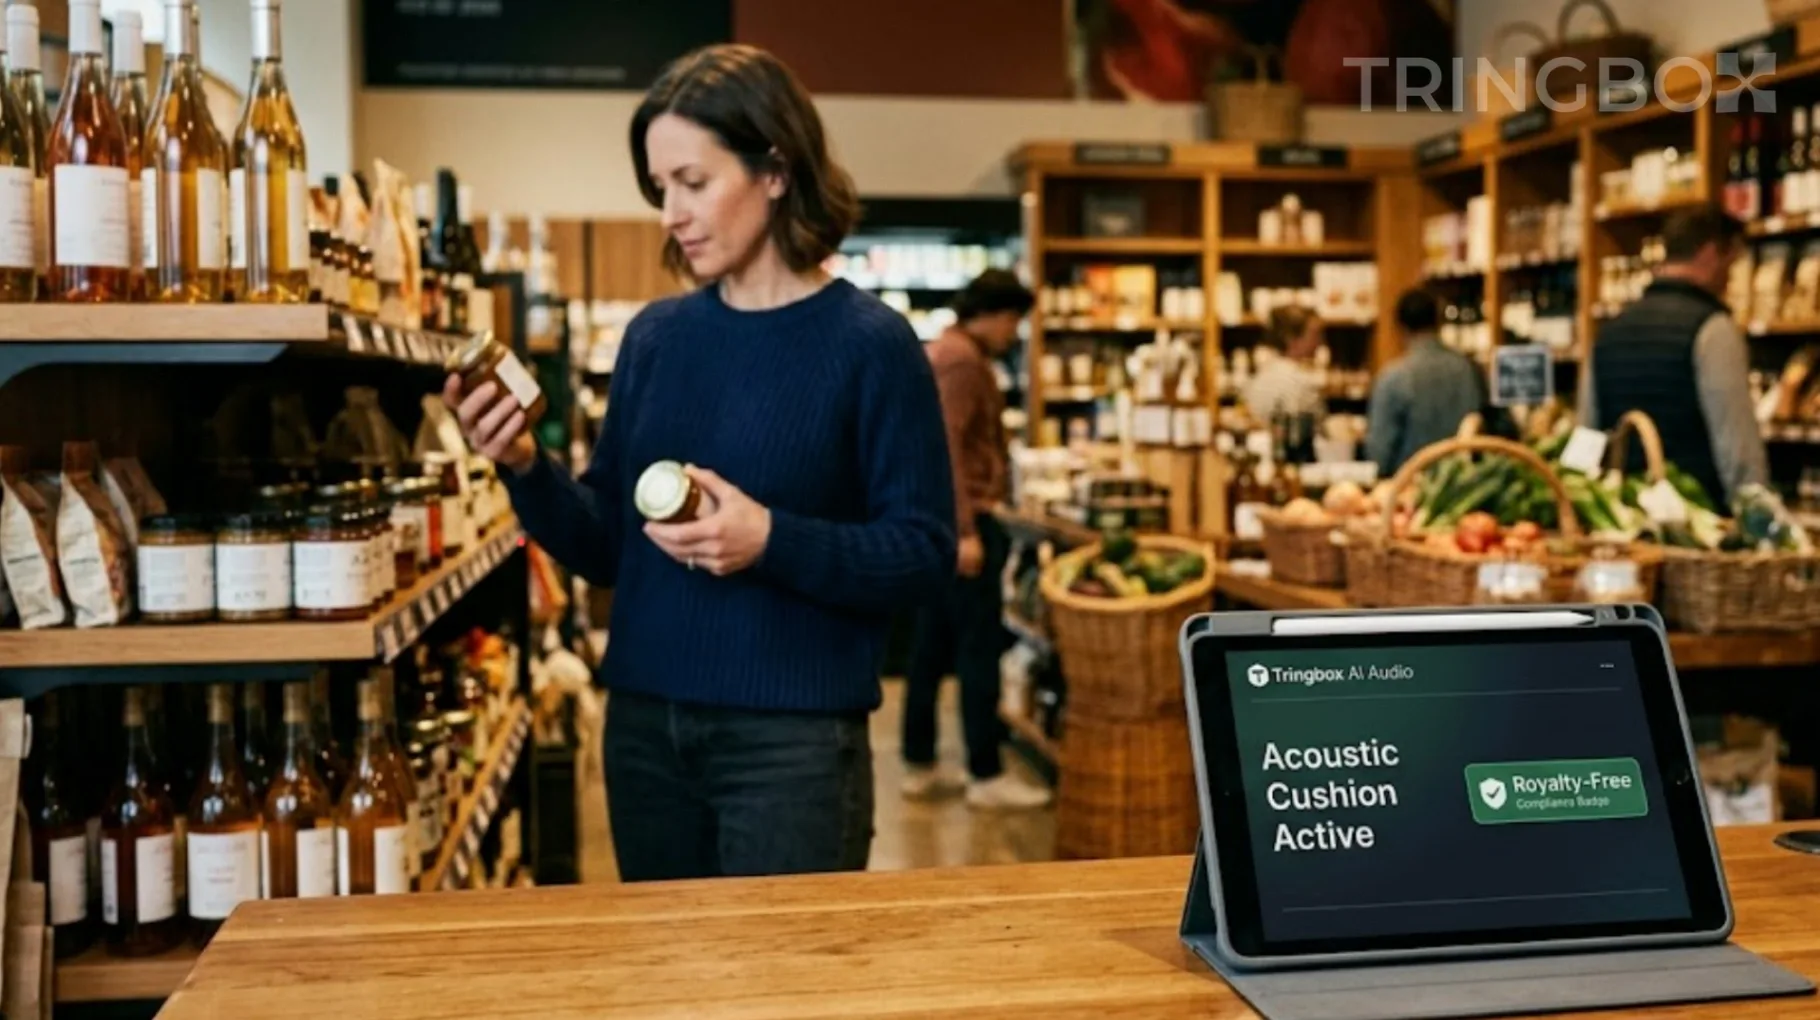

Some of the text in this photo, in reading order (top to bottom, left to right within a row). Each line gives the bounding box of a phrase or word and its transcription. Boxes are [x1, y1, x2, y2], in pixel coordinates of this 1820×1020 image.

[1272, 667, 1344, 687] Tringbox
[1368, 665, 1414, 680] Audio
[1262, 738, 1399, 770] Acoustic
[1267, 778, 1398, 811] Cushion
[1512, 771, 1633, 796] Royalty-Free
[1274, 820, 1375, 852] Active
